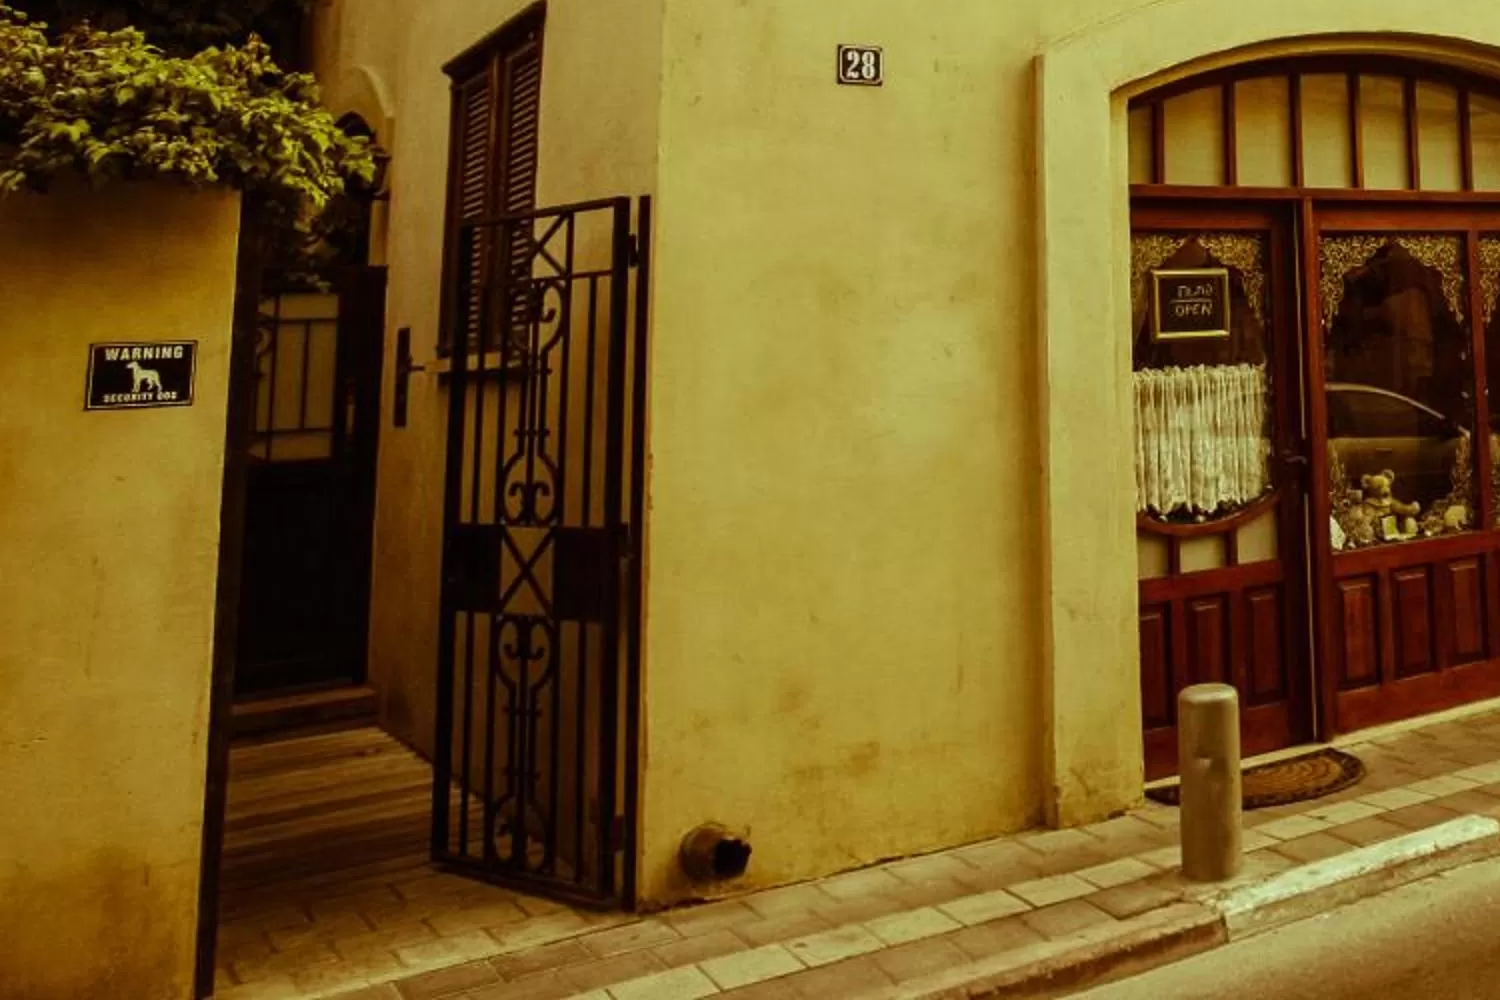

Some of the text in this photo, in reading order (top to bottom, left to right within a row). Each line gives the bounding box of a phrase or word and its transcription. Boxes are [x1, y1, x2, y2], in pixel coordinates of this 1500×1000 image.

[846, 50, 876, 79] 28
[1175, 303, 1213, 317] OPEN
[104, 345, 185, 361] WARNING
